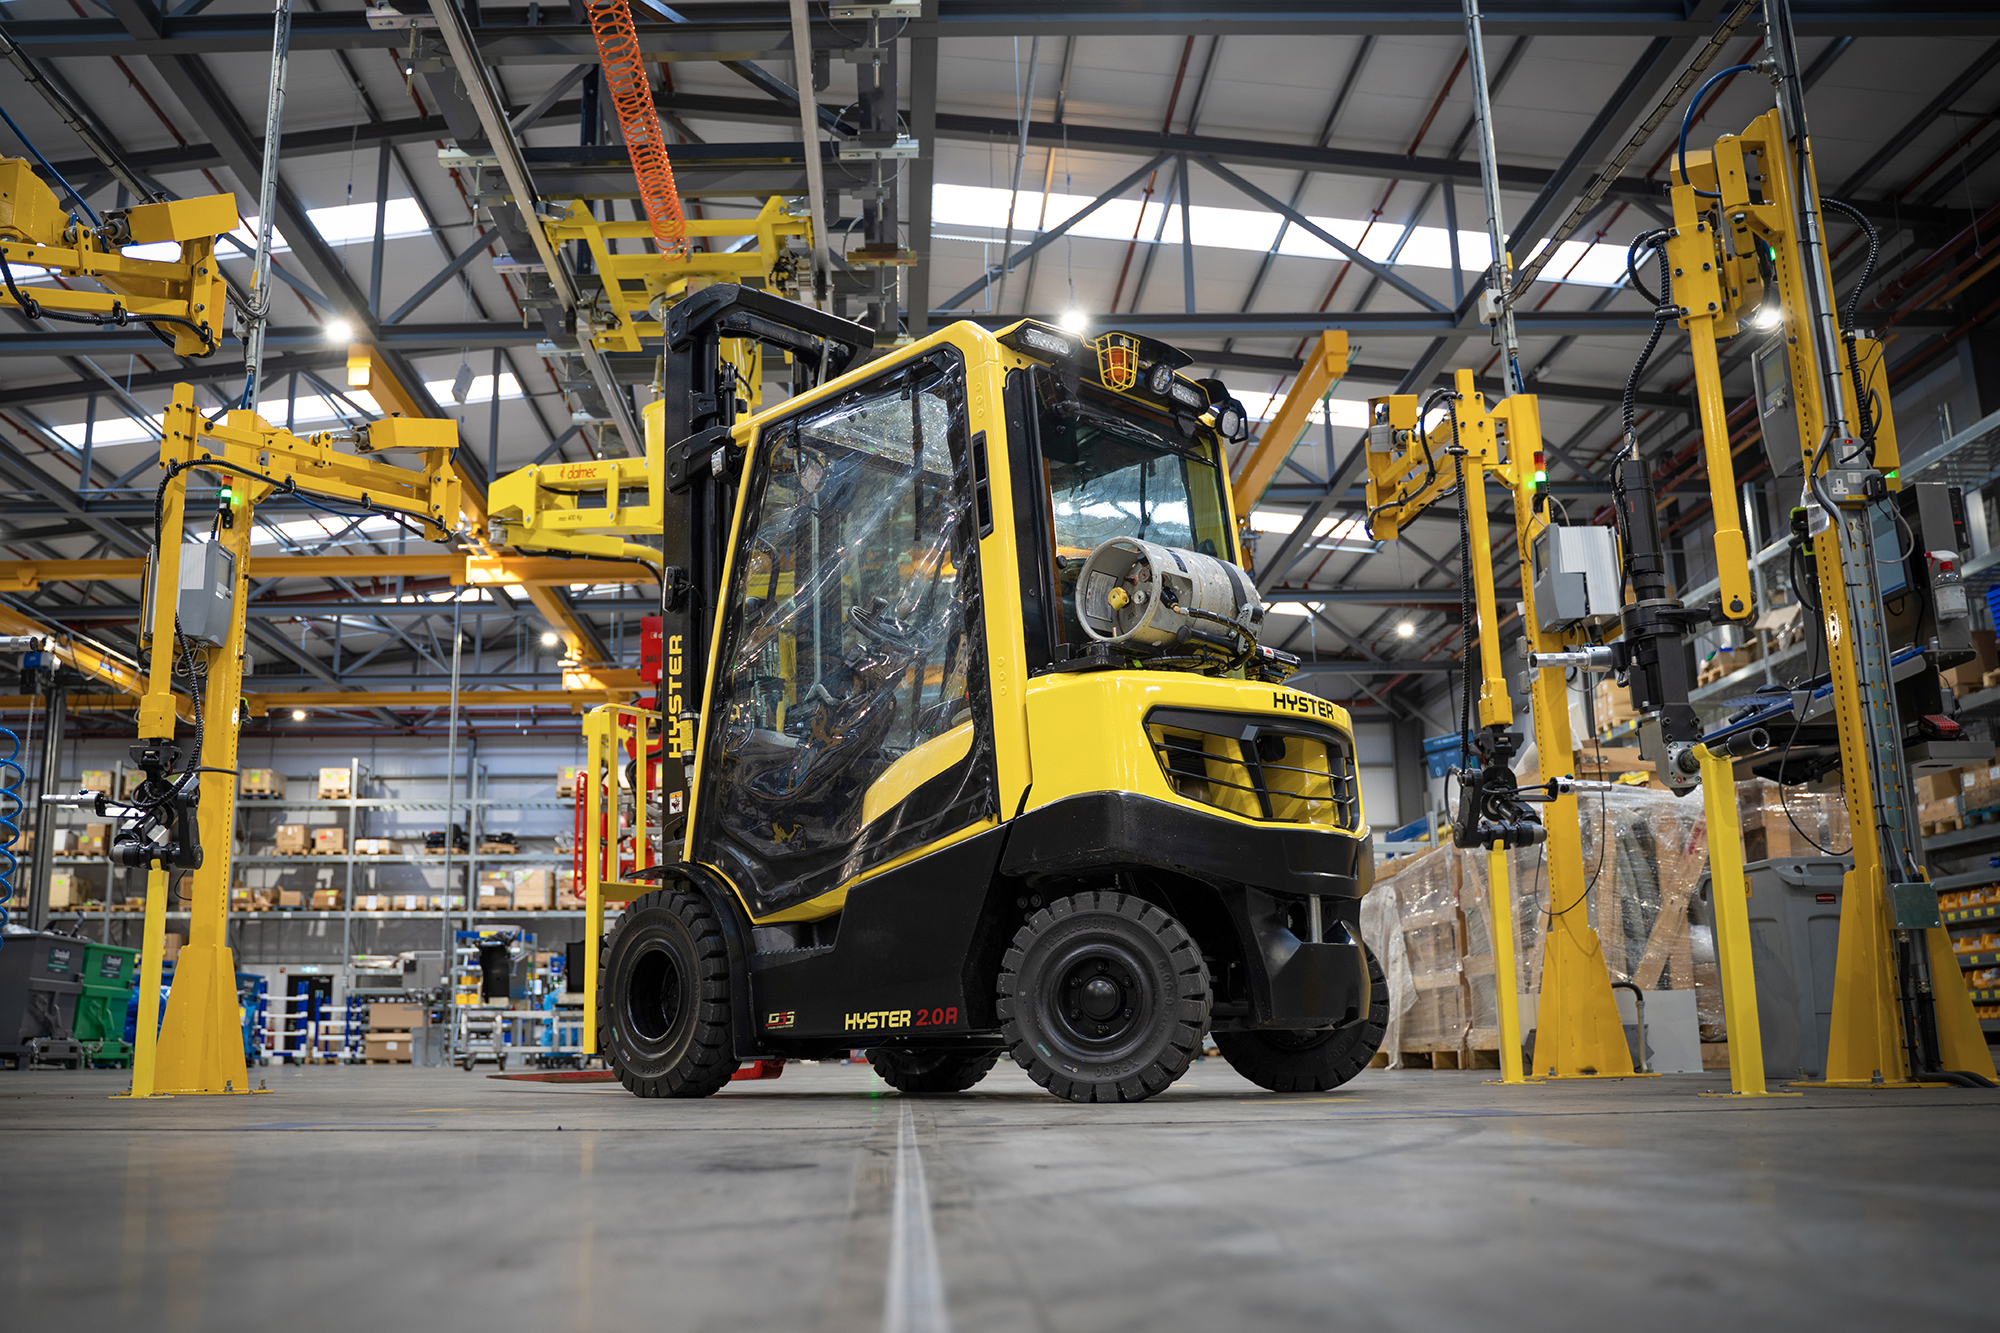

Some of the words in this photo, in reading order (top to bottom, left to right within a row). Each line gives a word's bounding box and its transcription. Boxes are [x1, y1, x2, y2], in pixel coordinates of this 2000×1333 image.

[567, 464, 597, 480] dalmec
[668, 634, 683, 759] HYSTER
[1273, 692, 1335, 720] HYSTER
[1040, 917, 1117, 951] TRELLEBORG
[845, 1010, 911, 1031] HYSTER
[916, 1007, 958, 1027] 2.0A
[1094, 1056, 1140, 1078] XP800
